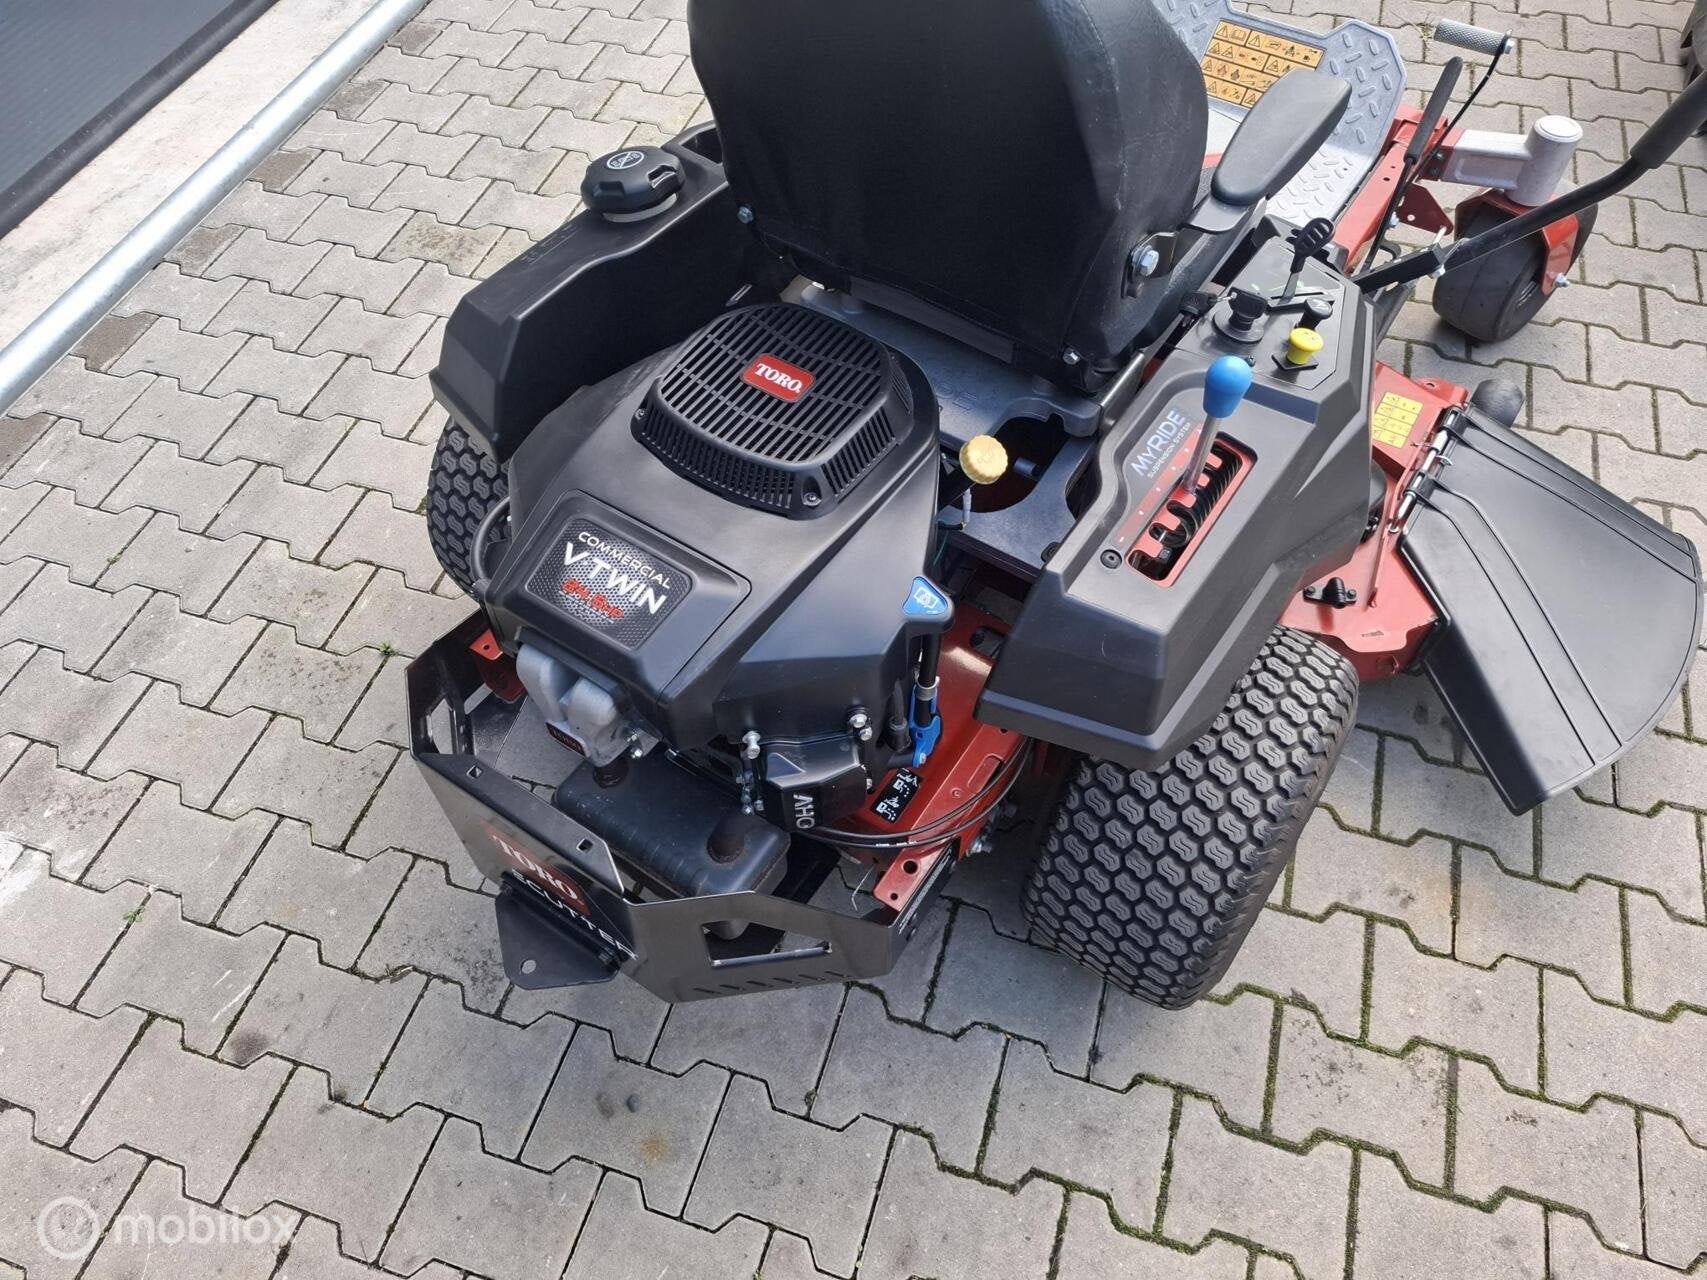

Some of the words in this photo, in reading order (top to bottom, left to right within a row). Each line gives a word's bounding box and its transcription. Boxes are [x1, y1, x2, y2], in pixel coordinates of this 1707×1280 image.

[754, 363, 803, 392] TORO
[1131, 409, 1185, 476] MYRIDE
[578, 531, 672, 589] COMMERCIAL
[793, 794, 815, 829] OHV
[492, 835, 579, 900] TORO
